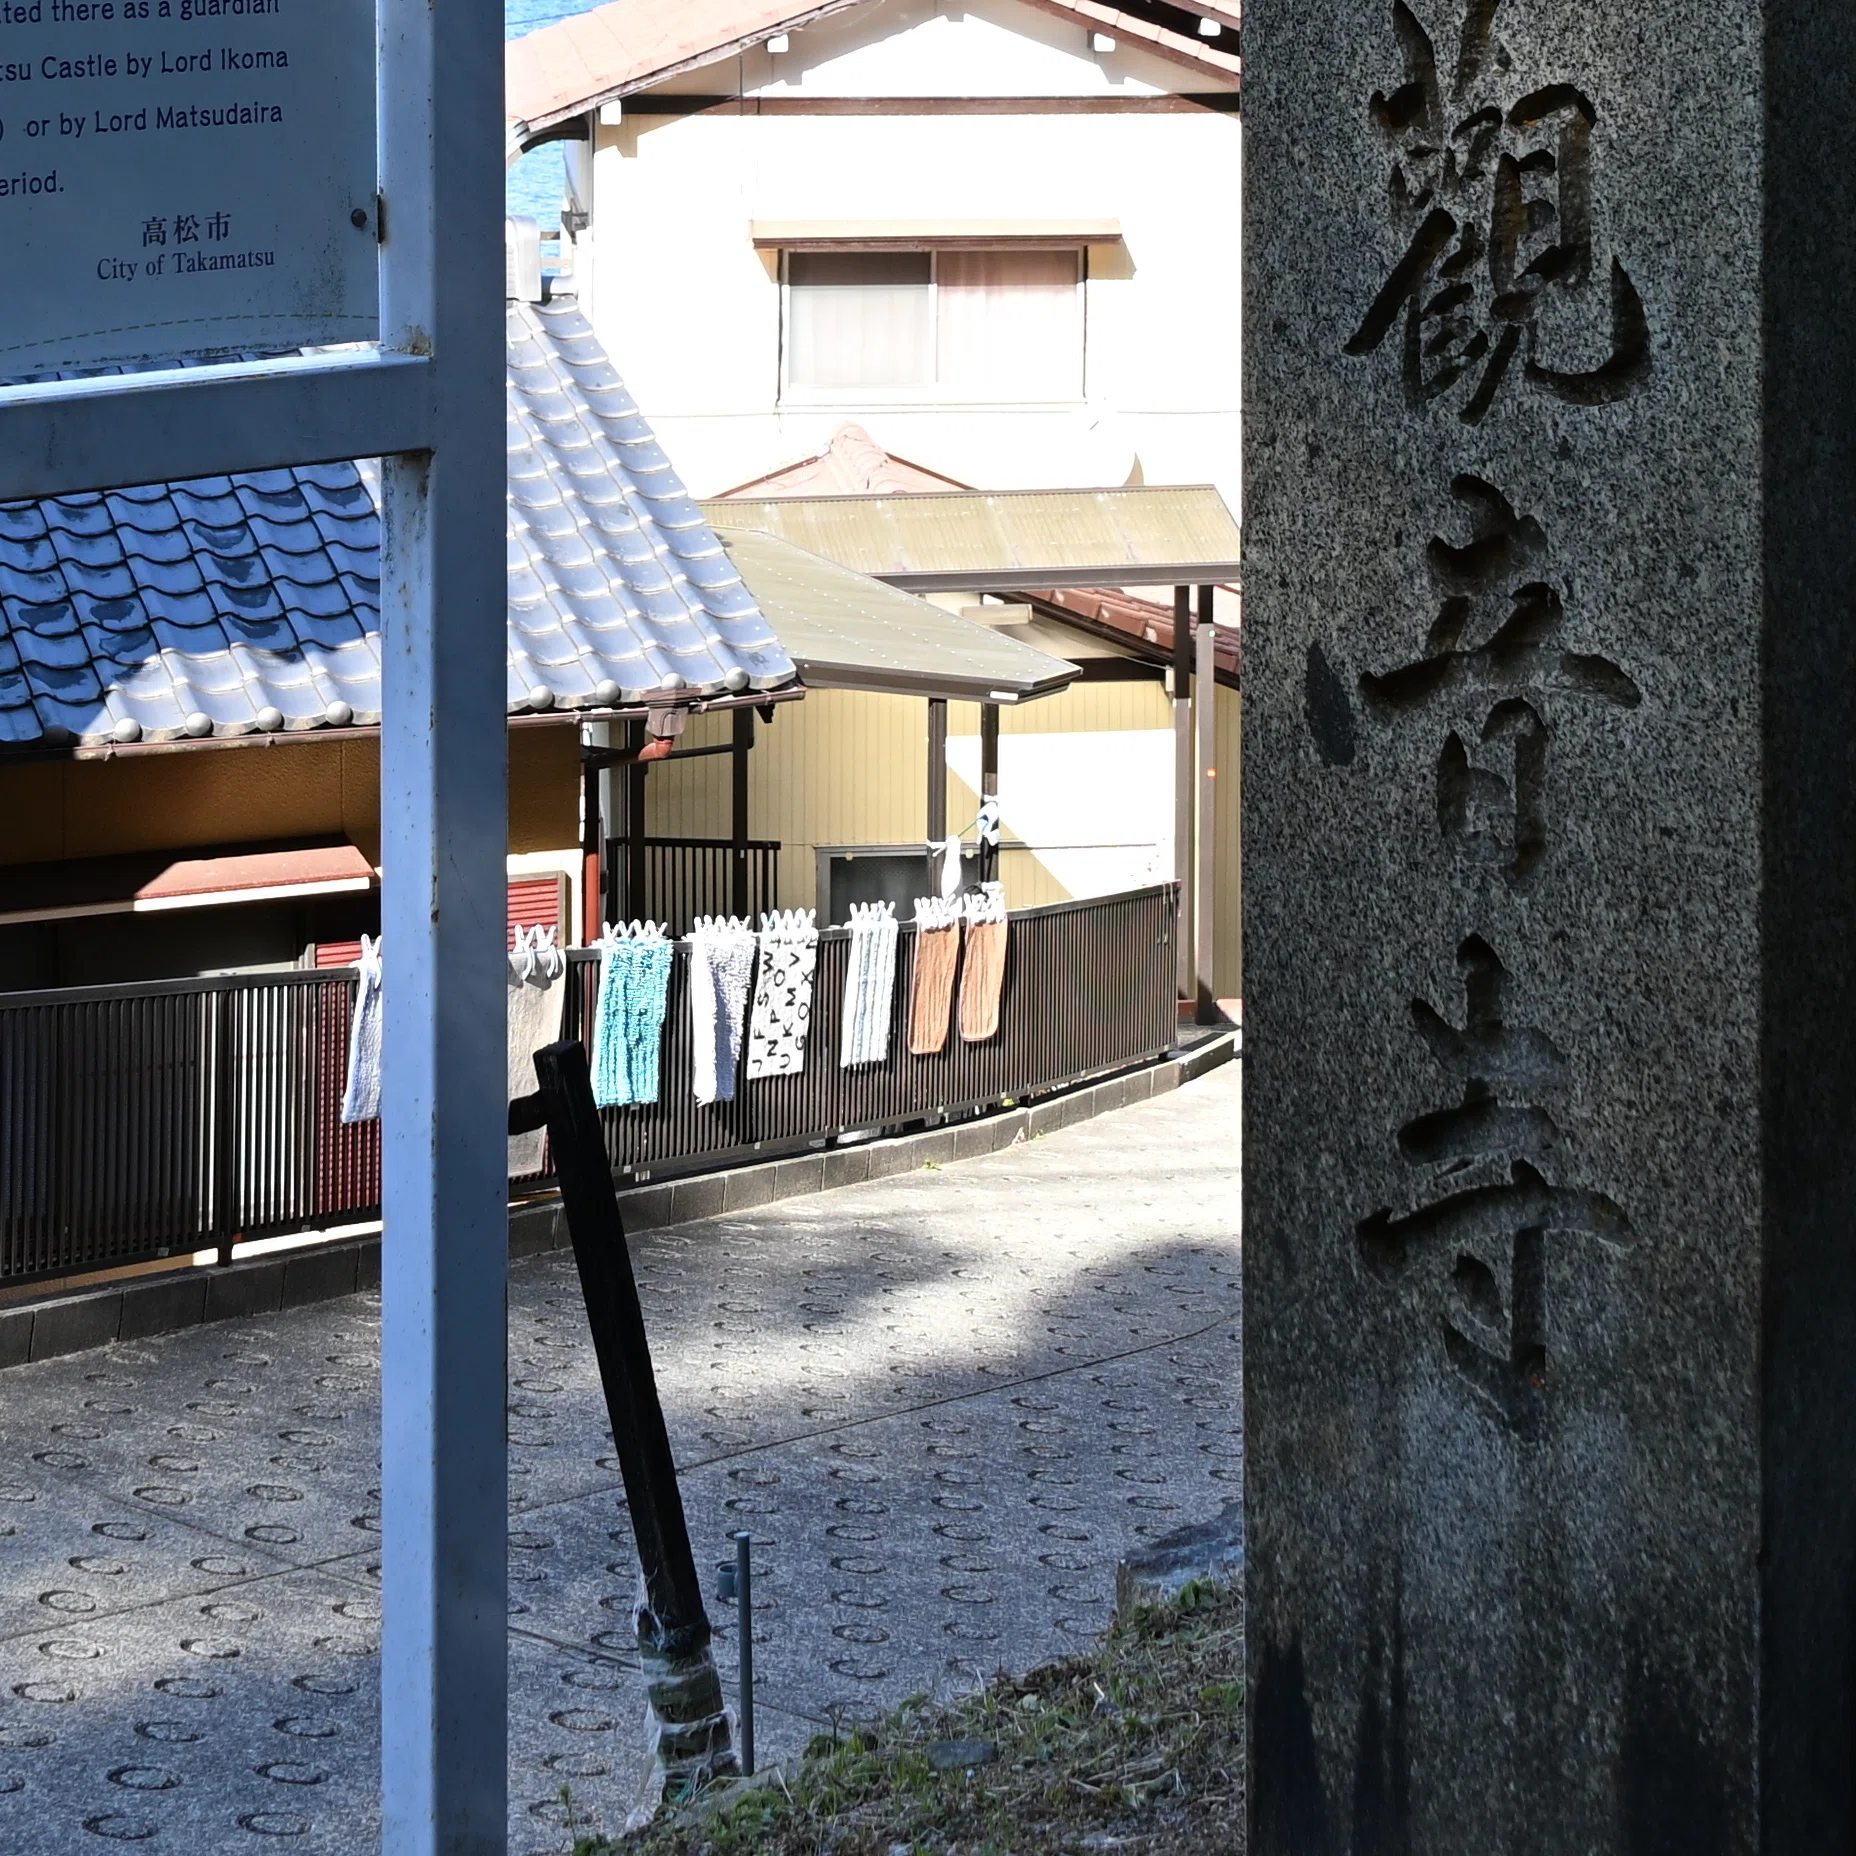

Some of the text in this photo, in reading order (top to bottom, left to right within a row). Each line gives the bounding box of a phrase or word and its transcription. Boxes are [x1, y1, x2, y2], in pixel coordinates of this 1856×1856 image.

[123, 0, 150, 20] as
[157, 0, 172, 18] a
[40, 53, 118, 80] Castle
[126, 51, 153, 79] by
[160, 48, 212, 74] Lord
[220, 47, 289, 71] Ikoma
[25, 119, 51, 138] or
[59, 112, 87, 139] by
[94, 107, 147, 134] Lord
[155, 100, 283, 130] Matsudaira
[141, 211, 232, 248] 高松市
[96, 250, 275, 282] City of Takamatsu
